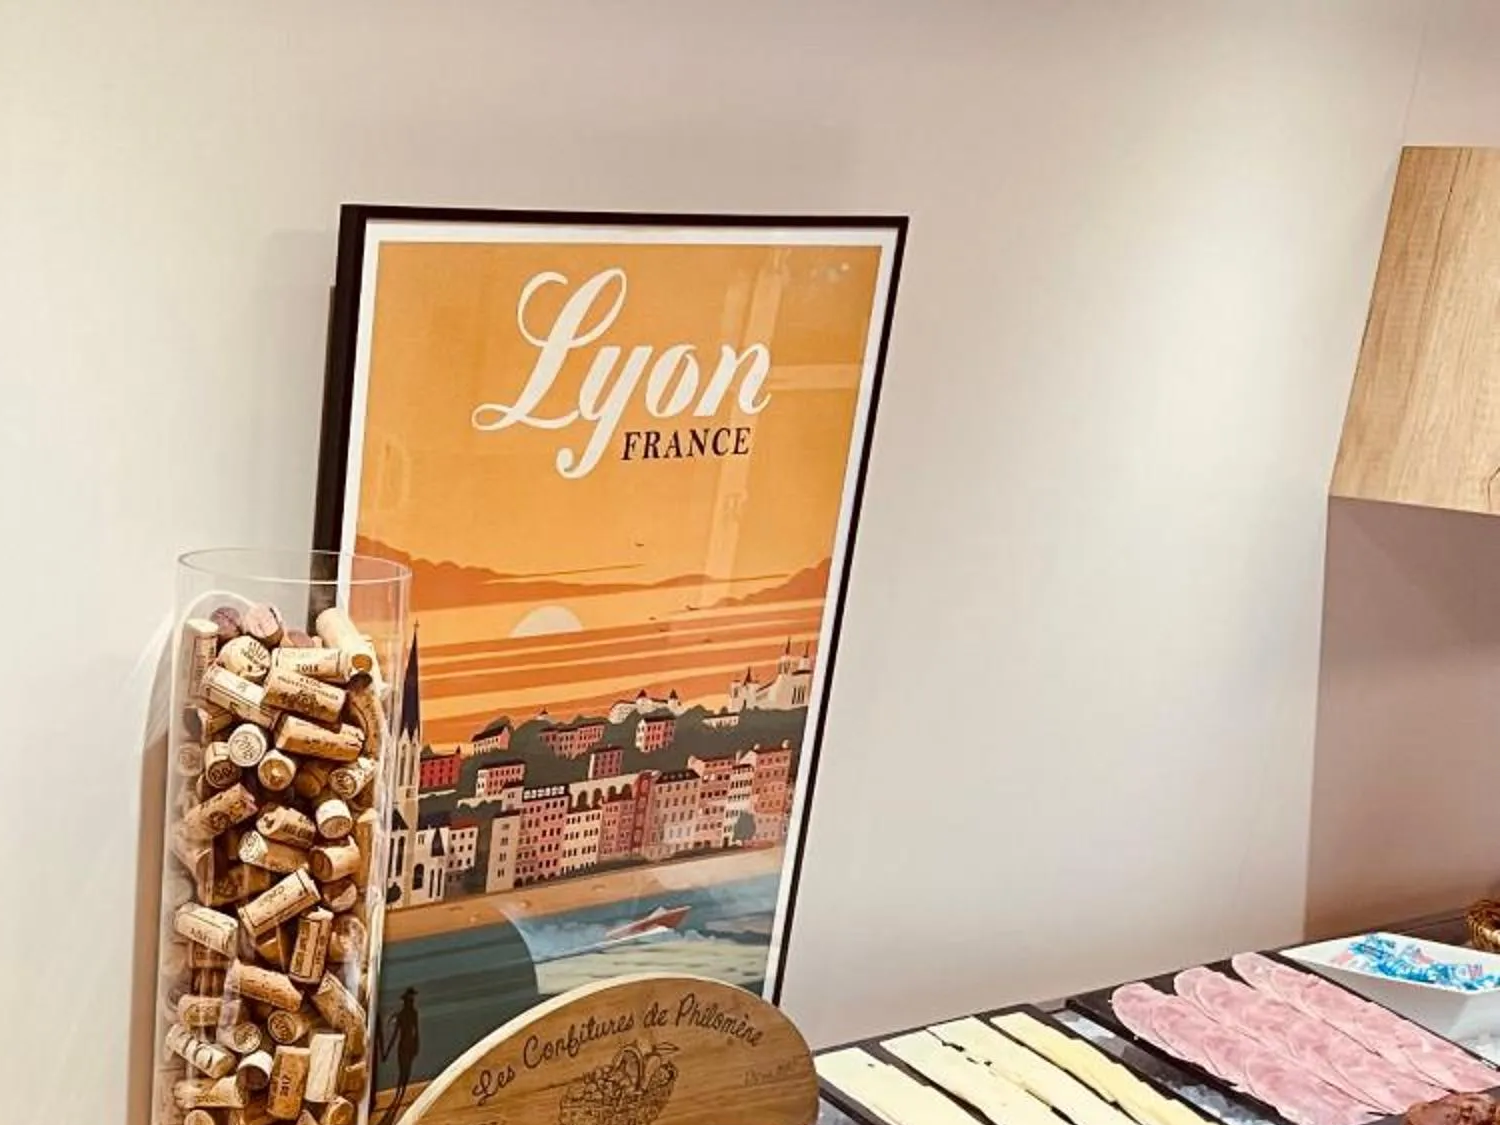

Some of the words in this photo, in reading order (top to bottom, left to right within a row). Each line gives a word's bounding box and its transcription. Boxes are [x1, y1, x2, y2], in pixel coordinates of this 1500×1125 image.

[471, 267, 772, 479] Lyon
[619, 426, 751, 461] FRANCE
[471, 1068, 516, 1106] Les
[522, 1014, 635, 1070] Confitures
[642, 1002, 668, 1027] de
[674, 993, 764, 1048] Philomène
